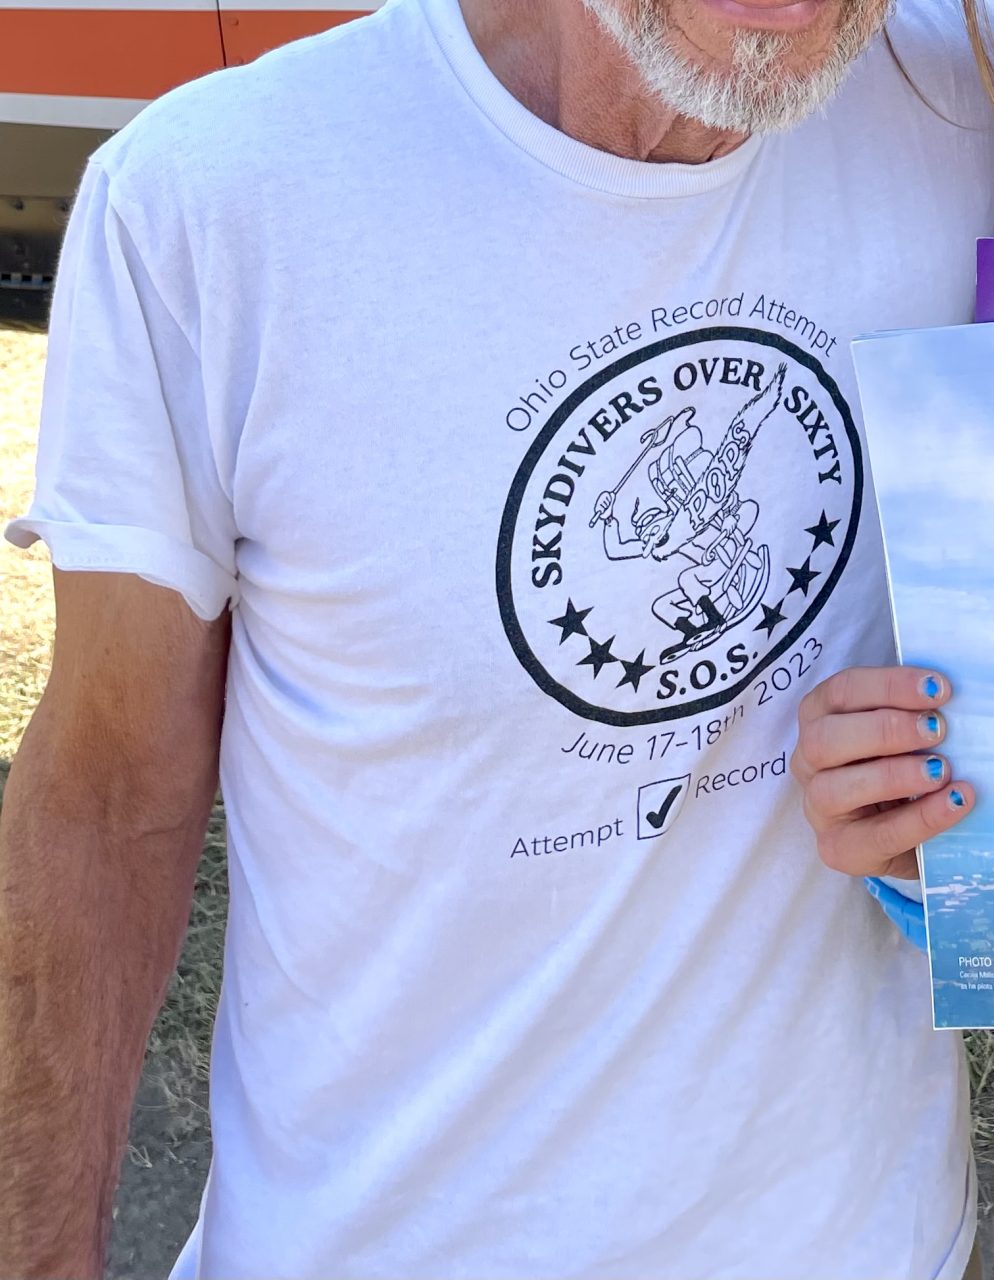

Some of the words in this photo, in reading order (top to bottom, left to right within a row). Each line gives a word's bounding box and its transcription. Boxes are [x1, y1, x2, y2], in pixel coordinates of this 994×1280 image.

[506, 369, 567, 432] Ohio
[569, 322, 643, 371] State
[651, 292, 744, 332] Record
[749, 294, 838, 357] Attempt
[532, 376, 663, 588] SKYDIVERS
[673, 357, 765, 391] OVER
[784, 386, 842, 486] SIXTY
[684, 419, 751, 530] POPS
[561, 732, 634, 764] June
[646, 704, 744, 761] 17-18th
[754, 637, 824, 706] 2023
[656, 643, 759, 700] S.O.S.
[510, 818, 624, 858] Attempt
[695, 751, 787, 799] Record
[958, 956, 992, 968] PHOTO
